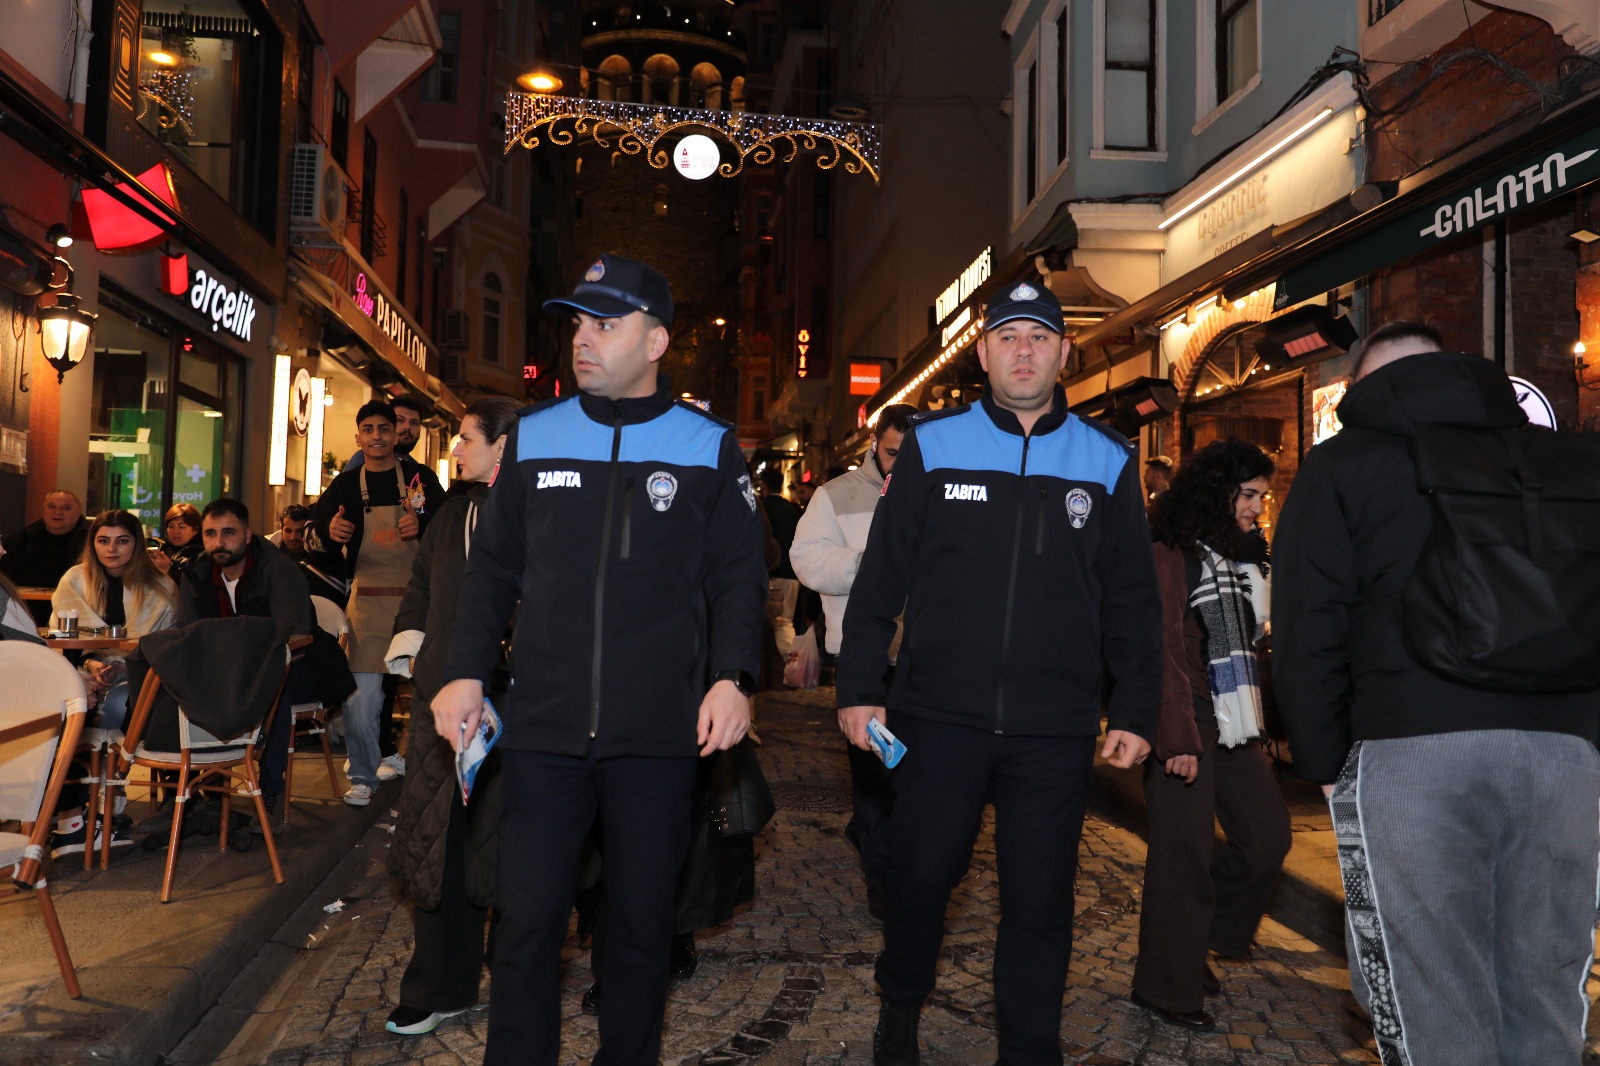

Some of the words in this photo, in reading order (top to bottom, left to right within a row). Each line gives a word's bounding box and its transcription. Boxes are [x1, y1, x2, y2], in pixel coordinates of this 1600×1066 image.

[1420, 149, 1599, 239] GALATA
[190, 269, 256, 342] arçelik
[536, 470, 582, 489] ZABITA
[944, 483, 988, 502] ZABITA
